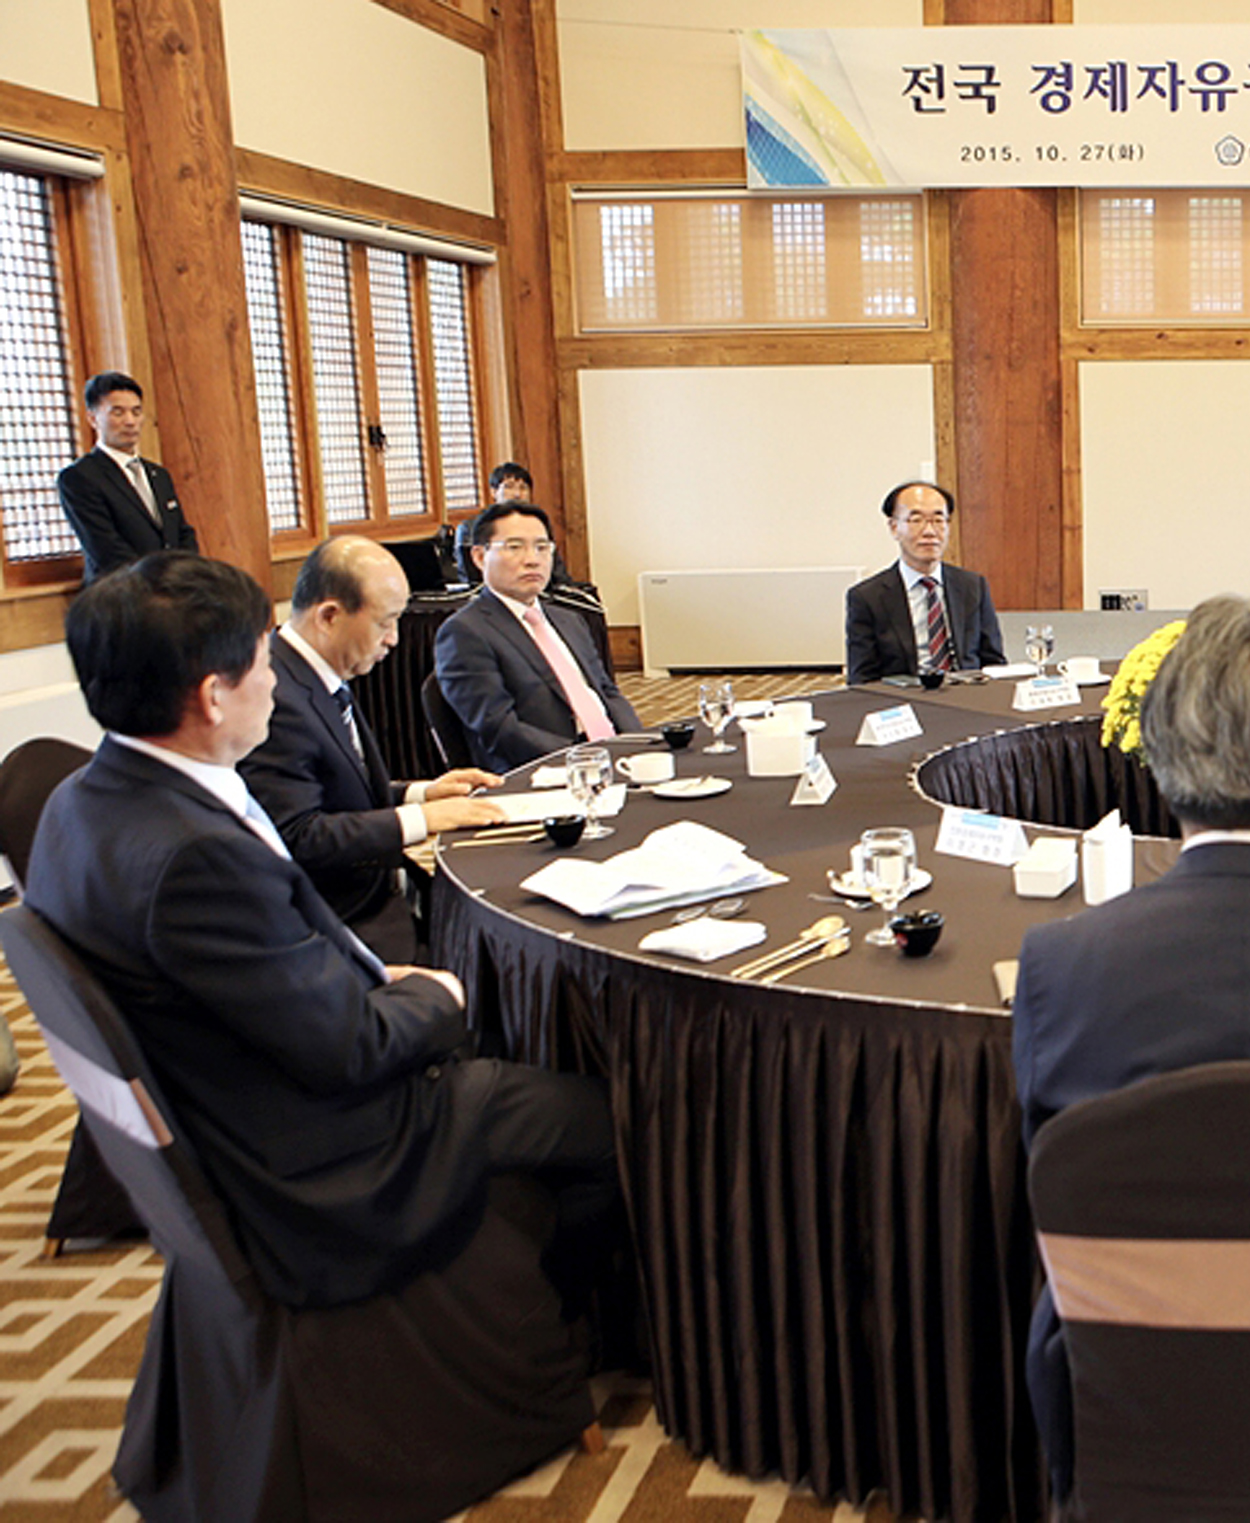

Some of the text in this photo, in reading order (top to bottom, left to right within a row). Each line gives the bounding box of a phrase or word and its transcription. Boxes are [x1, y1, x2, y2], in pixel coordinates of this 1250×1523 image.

[901, 63, 1002, 115] 전국
[960, 143, 1145, 163] 2015. 10. 27(화)
